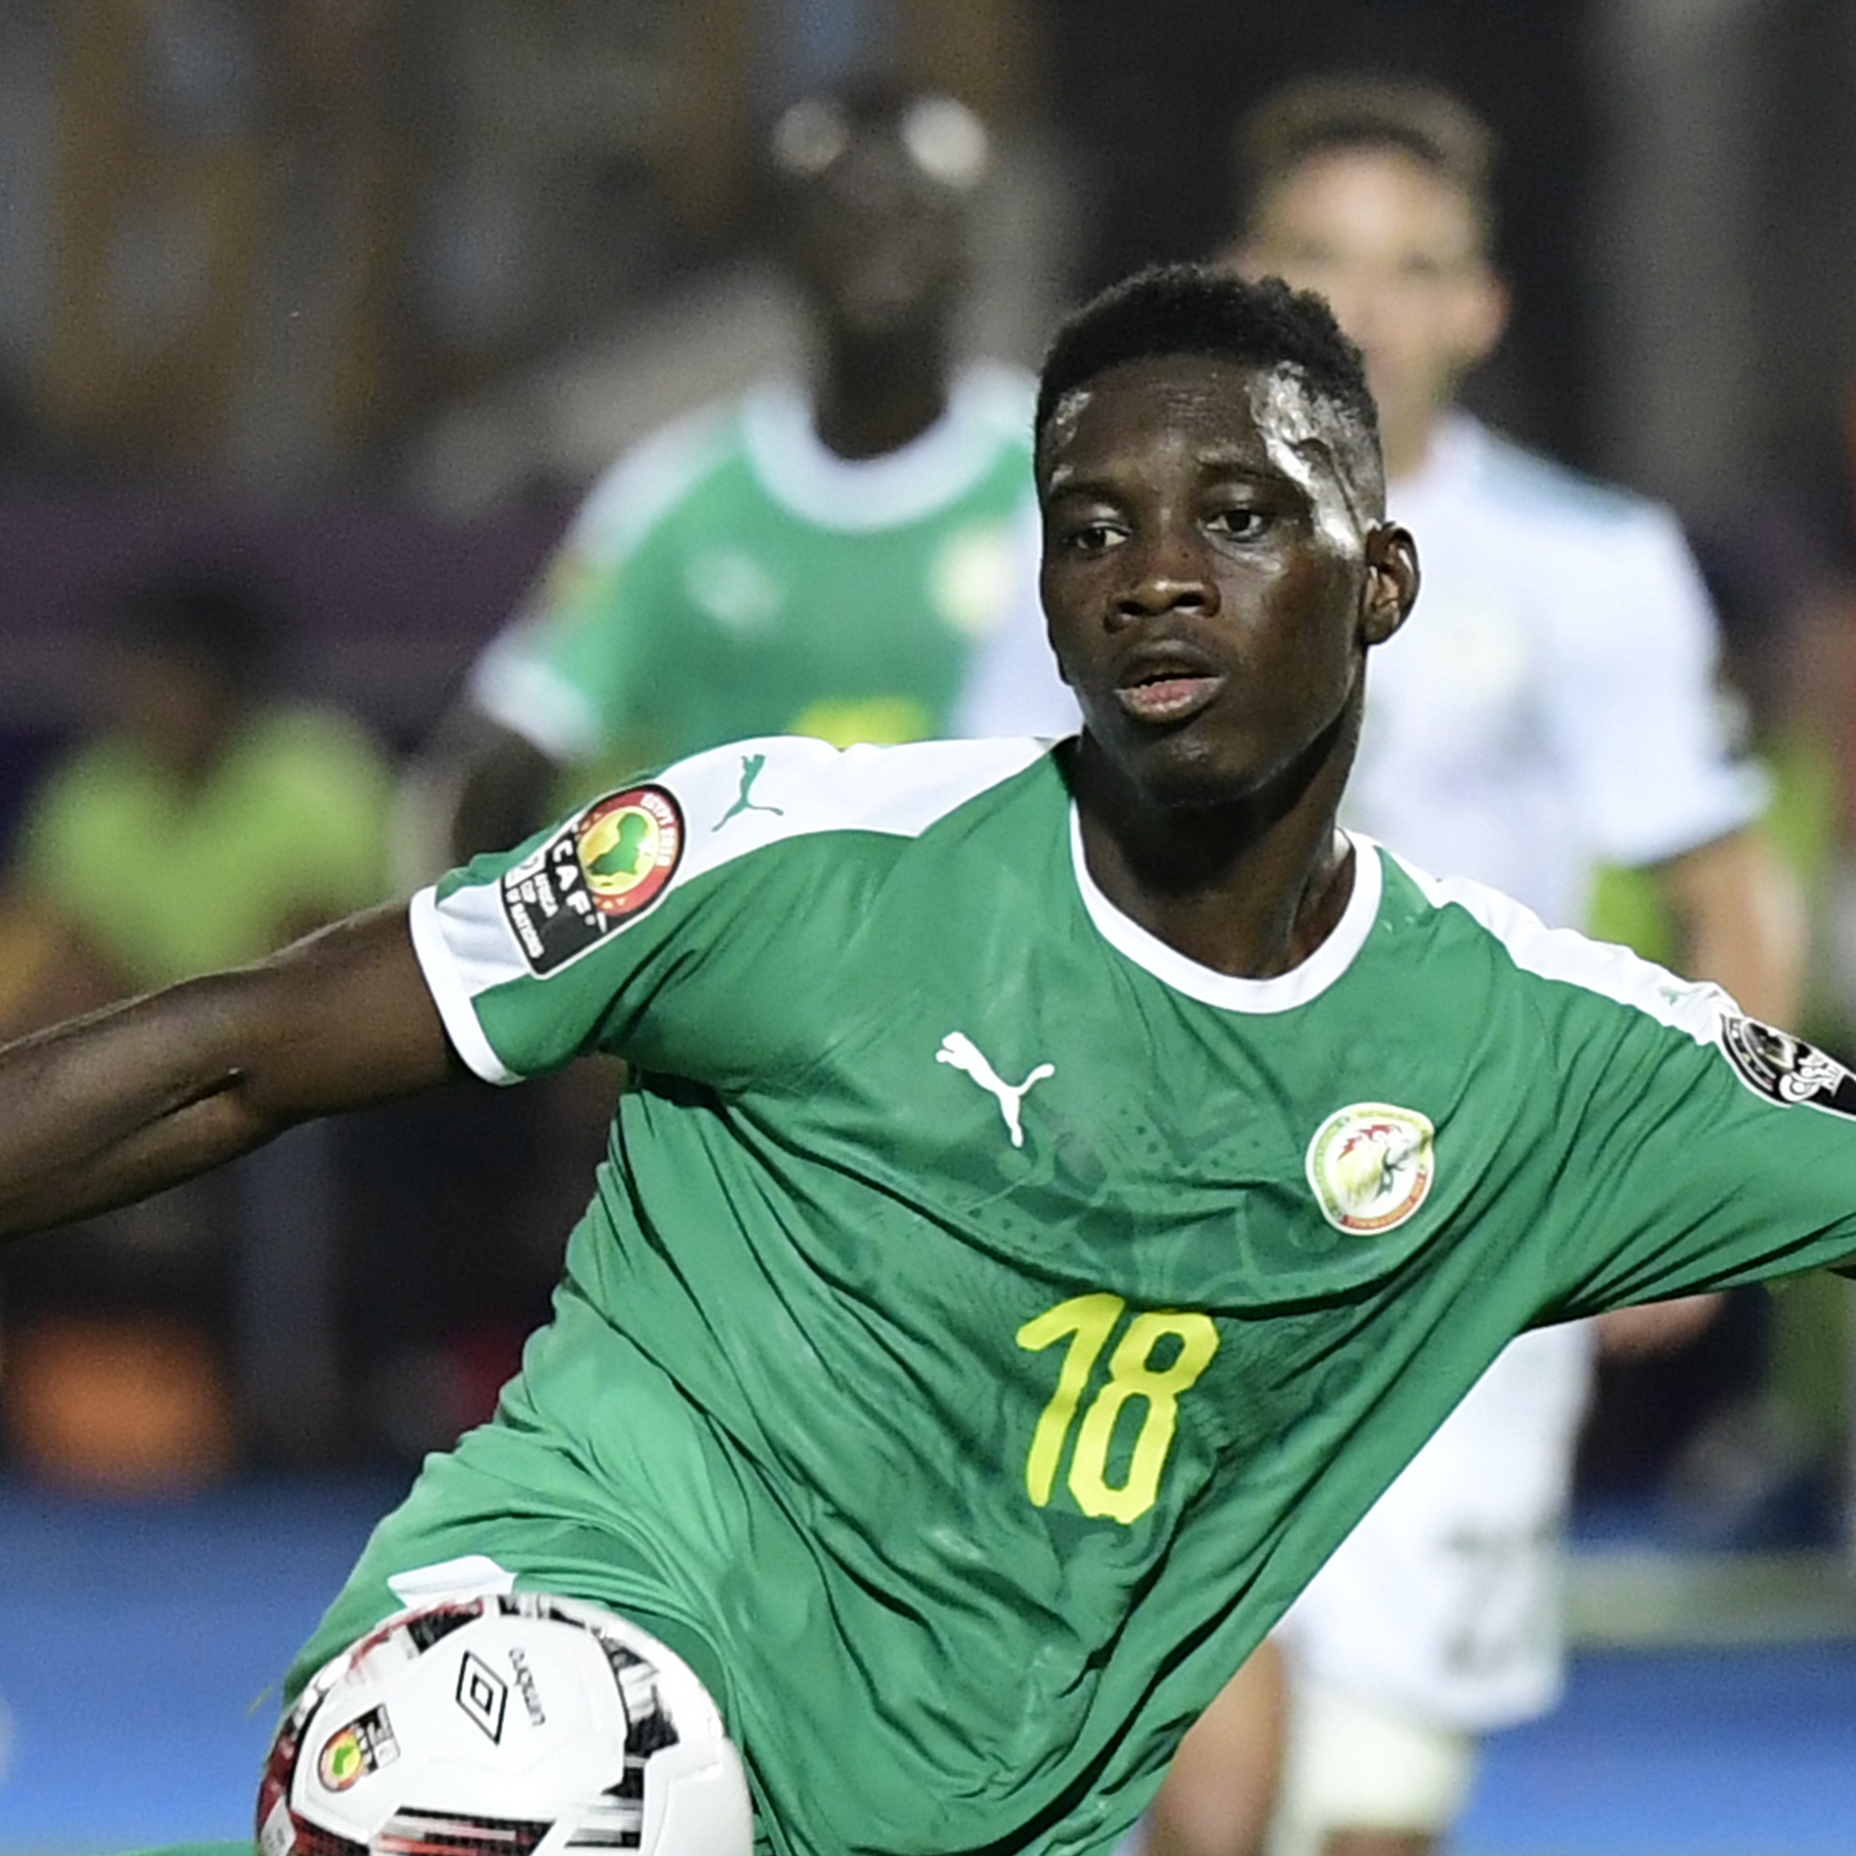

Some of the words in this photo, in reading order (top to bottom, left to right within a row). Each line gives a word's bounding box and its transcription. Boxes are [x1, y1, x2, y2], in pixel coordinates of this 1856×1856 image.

[552, 839, 592, 916] CAF
[509, 902, 545, 959] NATIONS
[1015, 1291, 1221, 1526] 18
